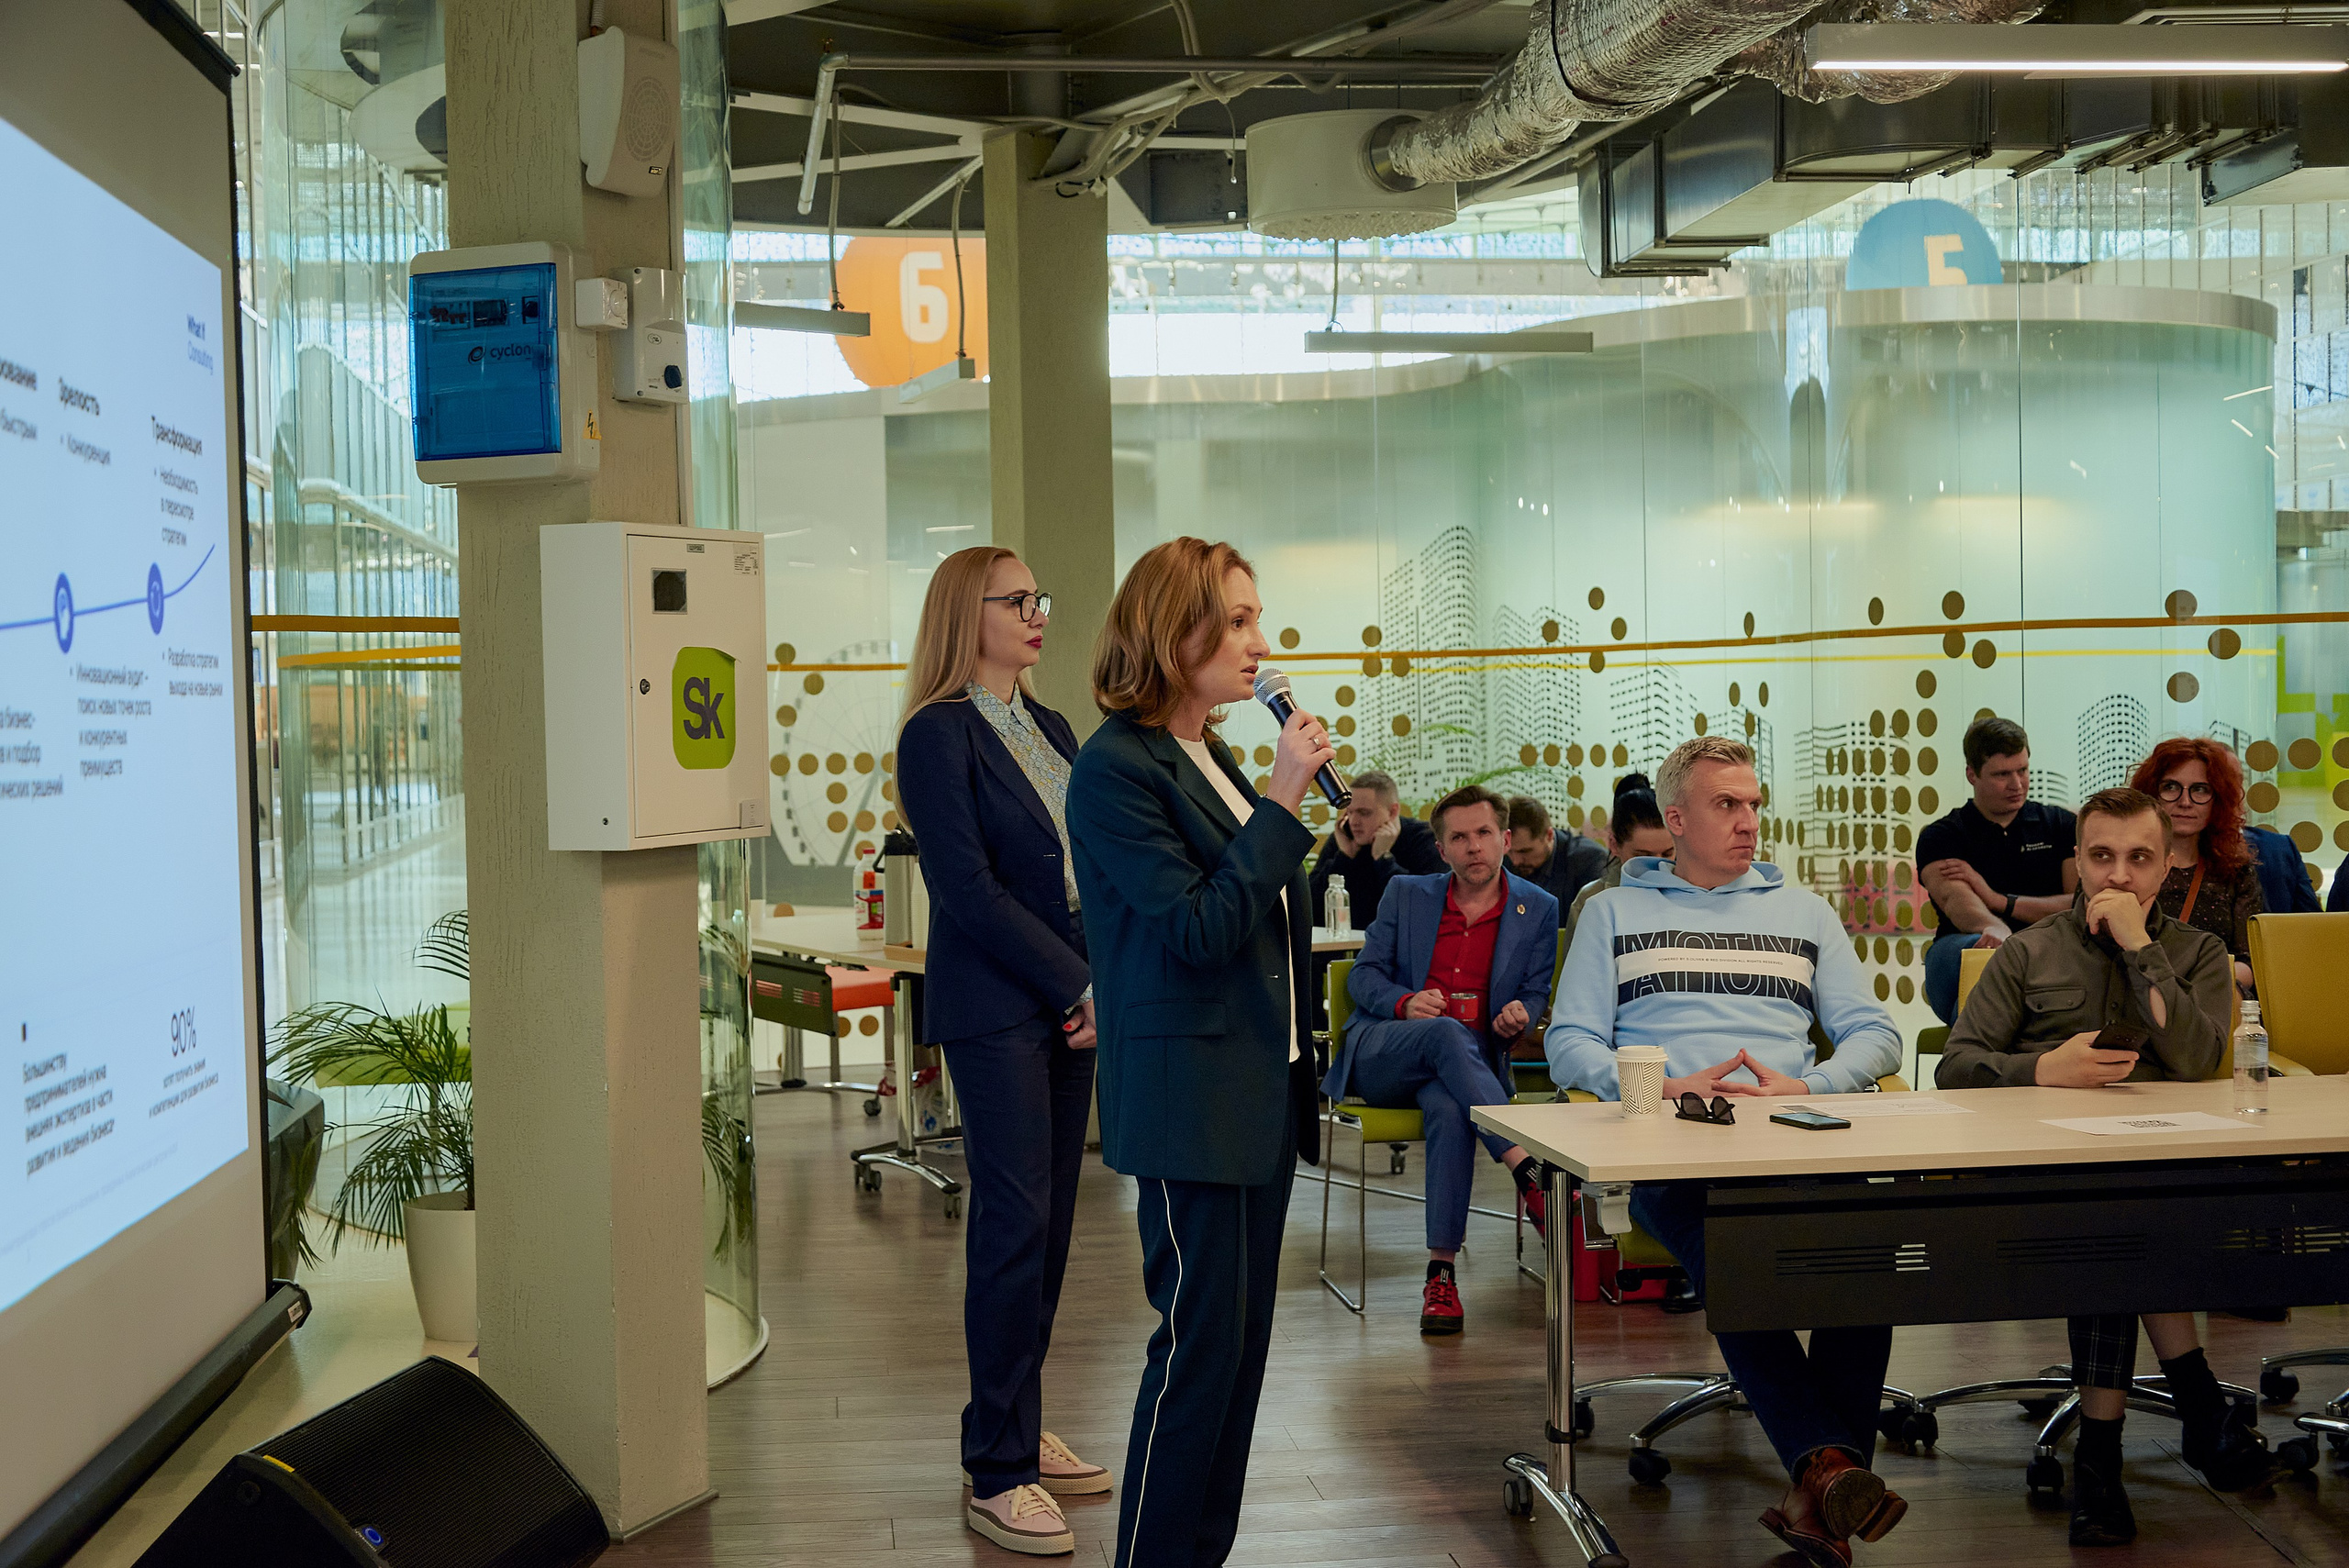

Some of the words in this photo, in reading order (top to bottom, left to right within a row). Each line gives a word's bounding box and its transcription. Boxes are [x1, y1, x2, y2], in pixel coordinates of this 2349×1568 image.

[900, 251, 949, 343] 6
[151, 416, 202, 457] Трансформация
[683, 676, 726, 740] Sk
[171, 1006, 196, 1057] 90%
